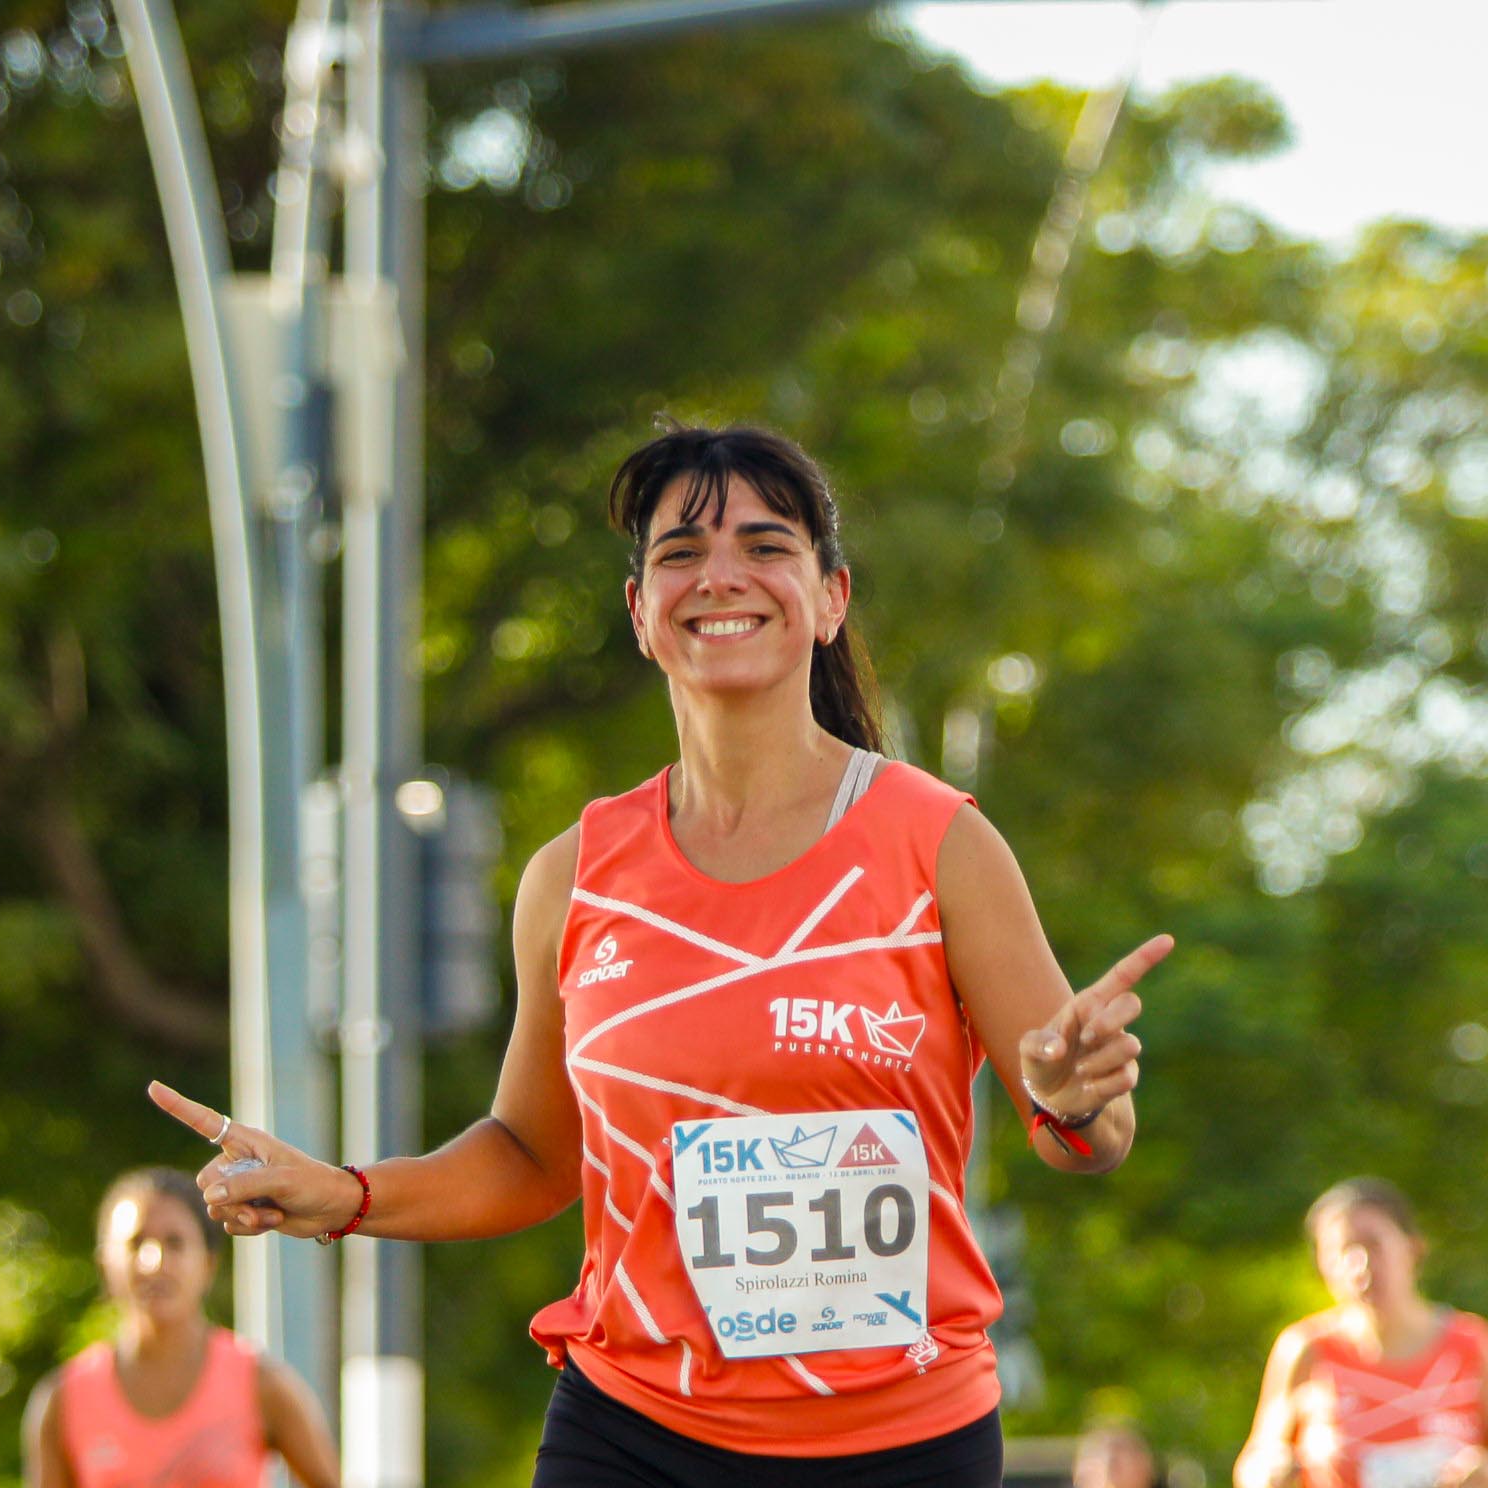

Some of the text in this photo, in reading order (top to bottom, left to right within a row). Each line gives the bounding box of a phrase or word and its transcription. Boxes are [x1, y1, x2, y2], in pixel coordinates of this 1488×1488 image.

[769, 997, 857, 1044] 15K
[697, 1138, 765, 1174] 15K
[850, 1142, 885, 1162] 15K
[698, 1177, 728, 1185] PUERTO
[731, 1175, 755, 1184] NORTE
[786, 1171, 820, 1181] ROSARIO
[841, 1169, 850, 1177] DE
[853, 1168, 874, 1176] ABRIL
[687, 1183, 916, 1269] 1510
[735, 1269, 868, 1294] Spirolazzi Romina
[717, 1307, 797, 1339] osde
